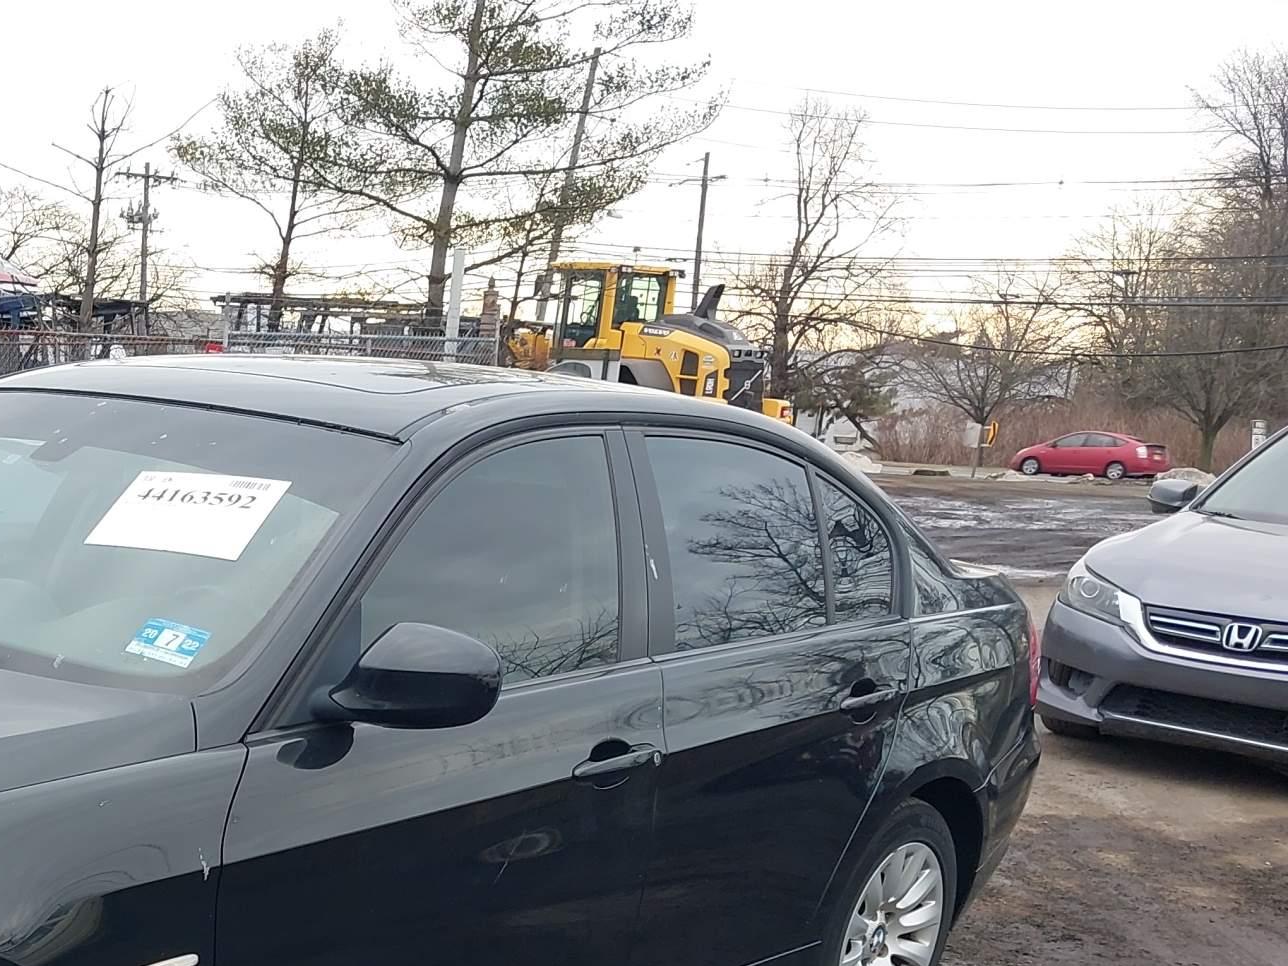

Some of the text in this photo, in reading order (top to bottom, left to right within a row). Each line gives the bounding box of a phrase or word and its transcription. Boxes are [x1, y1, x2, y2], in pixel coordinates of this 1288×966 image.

[137, 487, 257, 509] 44163592
[142, 627, 200, 650] 20 7 22
